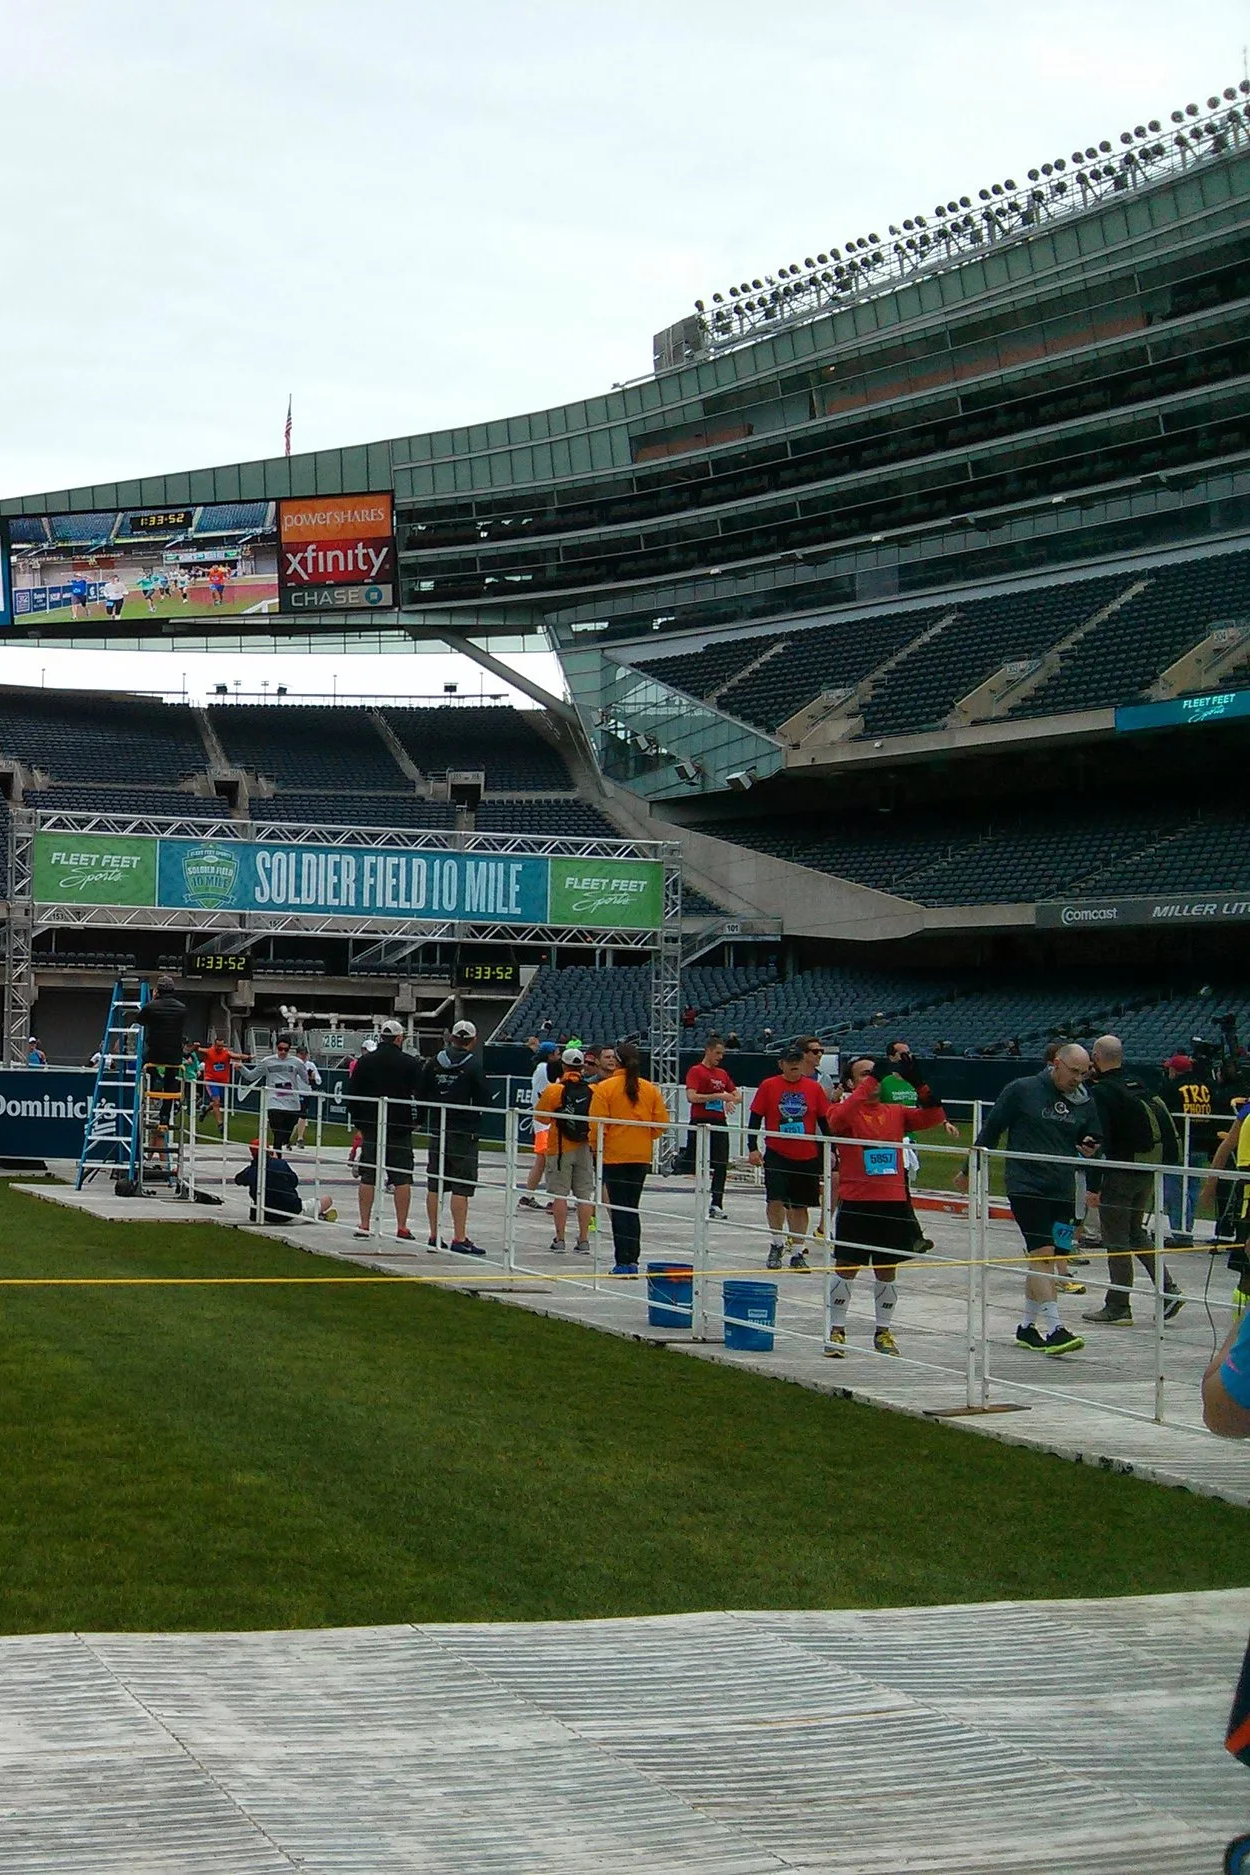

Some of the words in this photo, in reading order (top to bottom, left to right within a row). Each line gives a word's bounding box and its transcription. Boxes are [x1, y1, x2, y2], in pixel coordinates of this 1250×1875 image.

[285, 542, 389, 580] xfinity
[291, 589, 360, 607] CHASE
[1182, 697, 1211, 709] FLEET
[1212, 693, 1236, 705] FEET
[51, 852, 99, 866] FLEET
[101, 855, 141, 869] FEET
[59, 867, 128, 890] Sports
[187, 866, 215, 875] SOLDIER
[216, 866, 234, 876] FIELD
[254, 850, 356, 907] SOLDIER
[363, 856, 427, 909] FIELD
[432, 859, 456, 911] 10
[464, 860, 522, 914] MILE
[565, 877, 609, 891] FLEET
[610, 879, 648, 892] FEET
[573, 891, 639, 912] Sports
[1152, 903, 1217, 918] MILLER
[1222, 902, 1250, 914] LIT
[1178, 1085, 1210, 1103] TRC
[1183, 1103, 1211, 1115] PHOTO
[870, 1153, 893, 1165] 5857
